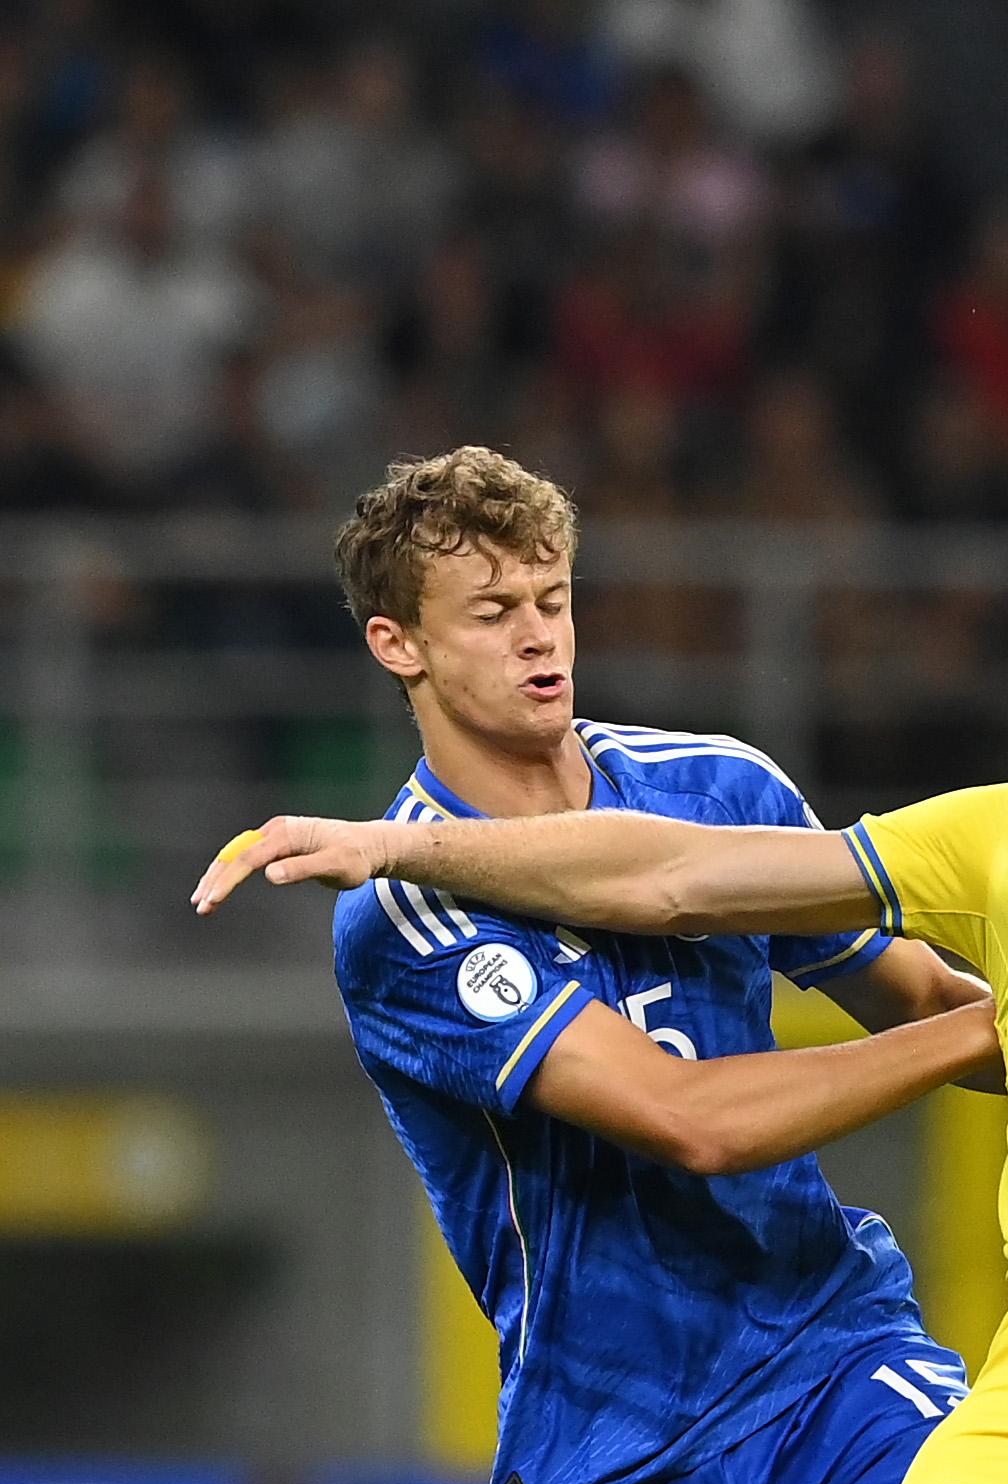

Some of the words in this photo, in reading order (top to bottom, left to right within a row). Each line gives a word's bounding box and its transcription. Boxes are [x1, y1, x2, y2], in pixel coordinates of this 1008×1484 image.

[466, 953, 502, 988] EUROPEAN
[473, 959, 508, 993] CHAMPIONS
[618, 981, 698, 1061] 5
